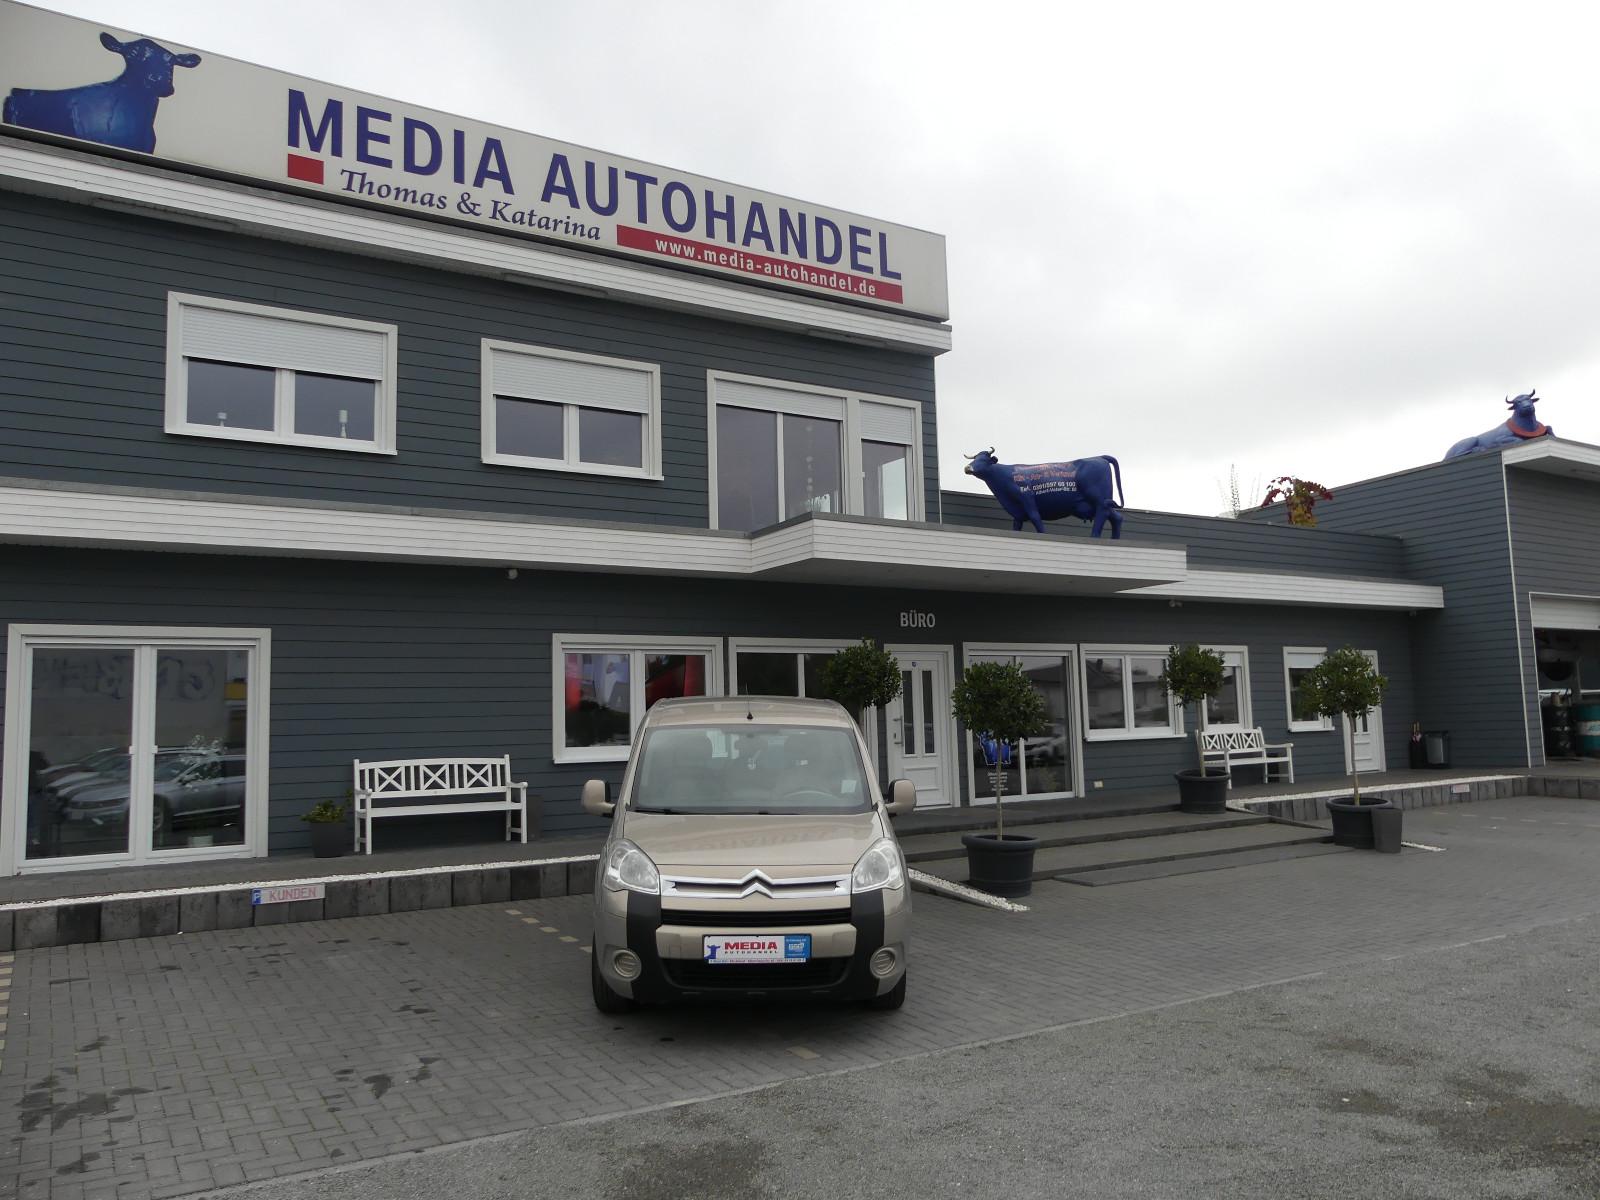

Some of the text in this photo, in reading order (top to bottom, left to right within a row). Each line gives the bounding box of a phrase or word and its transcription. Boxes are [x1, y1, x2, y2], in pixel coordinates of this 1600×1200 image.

[288, 88, 902, 280] MEDIA AUTOHANDEL
[340, 168, 601, 241] Thomas & Katarina
[655, 237, 876, 297] www.media-autohandel.de
[900, 609, 936, 628] BÜRO
[269, 886, 317, 901] KUNDEN
[724, 941, 778, 950] MEDIA
